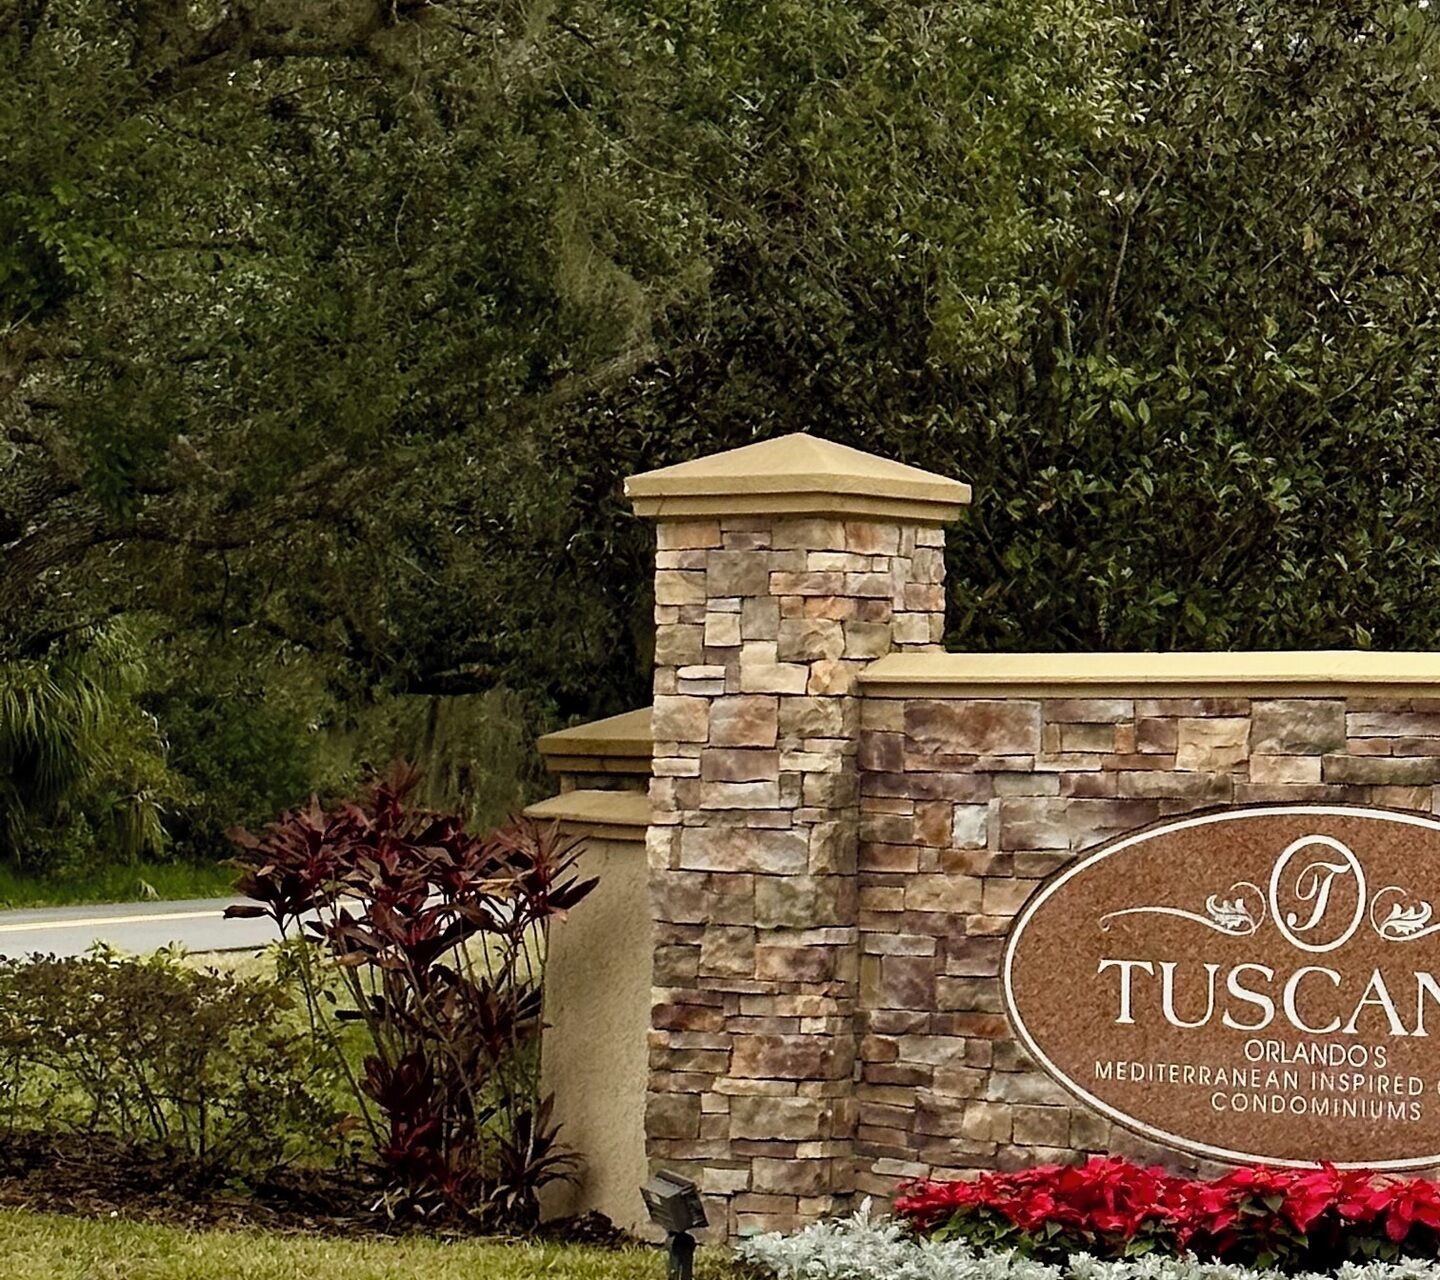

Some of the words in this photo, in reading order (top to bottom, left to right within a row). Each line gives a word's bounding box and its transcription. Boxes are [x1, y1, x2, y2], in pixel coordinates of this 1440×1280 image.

[1287, 862, 1351, 931] T
[1244, 1038, 1387, 1070] ORLANDO'S
[1095, 1061, 1298, 1091] MEDITERRANEAN
[1311, 1071, 1424, 1096] INSPIRED
[1211, 1091, 1422, 1121] CONDOMINIUMS
